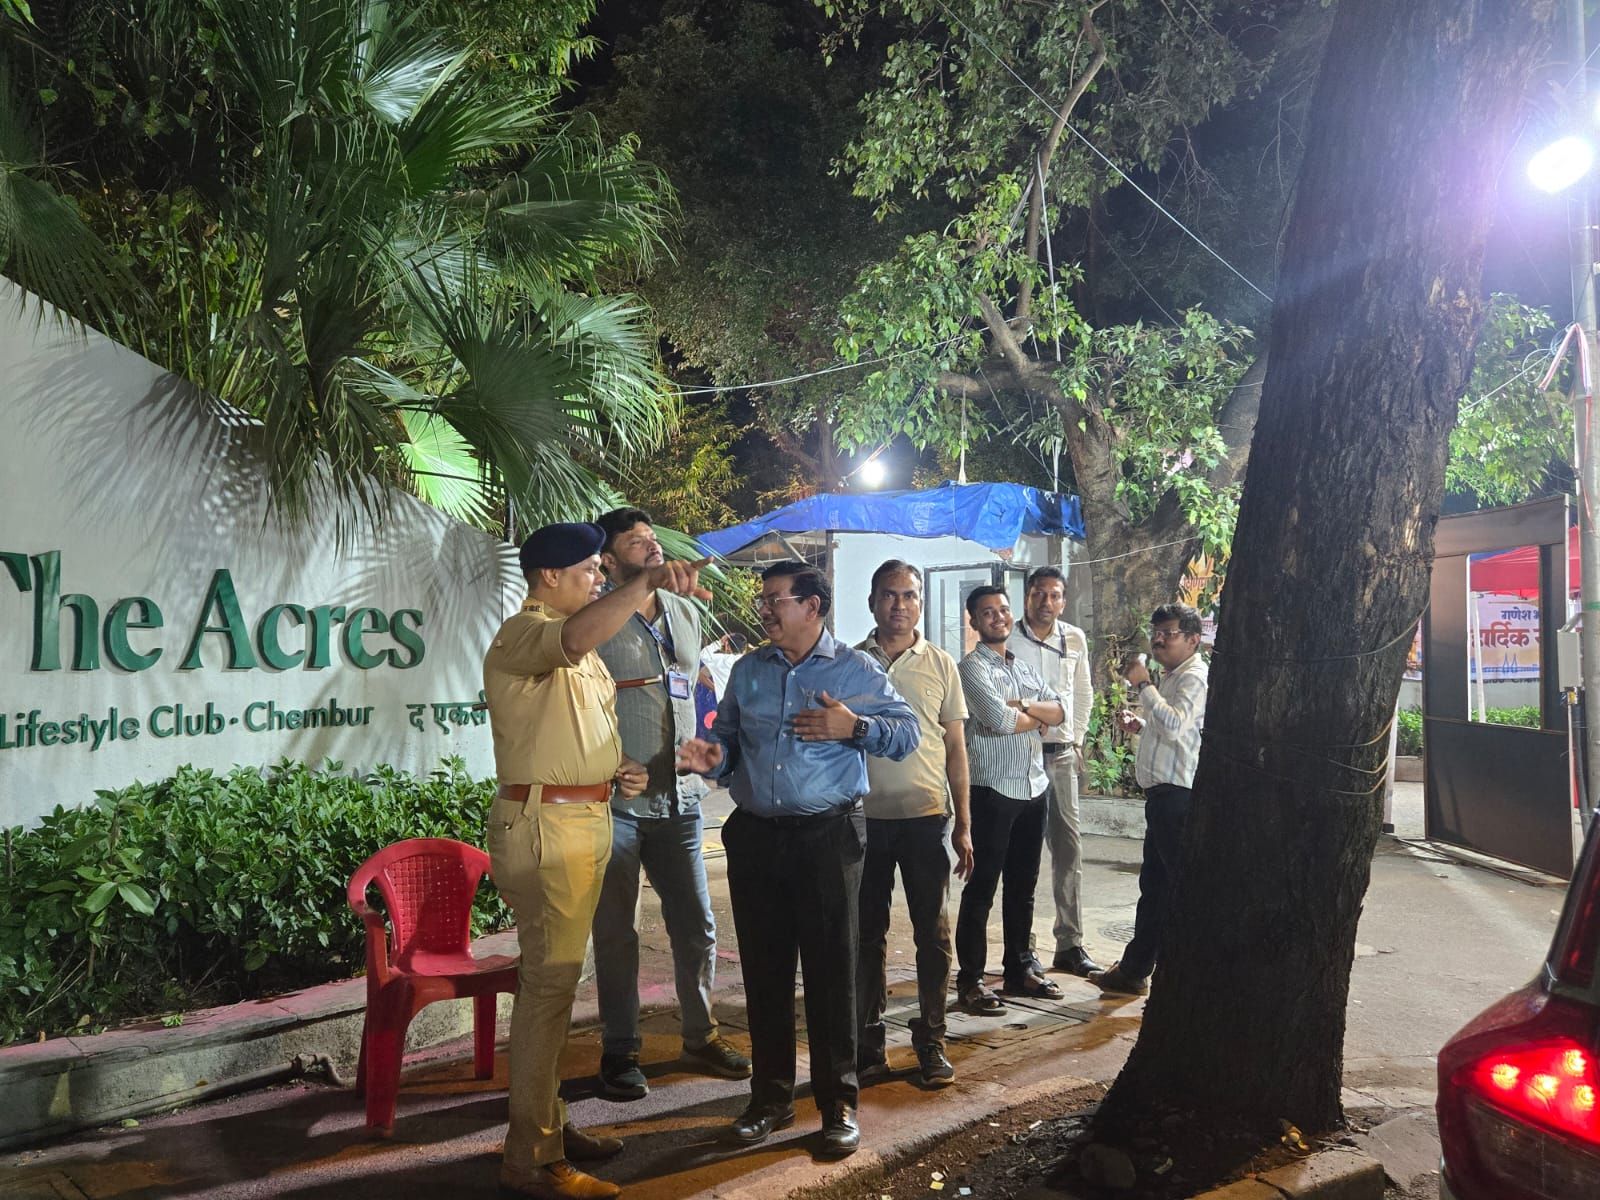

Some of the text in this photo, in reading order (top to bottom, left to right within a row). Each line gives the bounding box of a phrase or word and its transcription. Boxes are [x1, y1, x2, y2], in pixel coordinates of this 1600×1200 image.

[178, 568, 426, 670] Acres
[1501, 606, 1532, 620] गणेश
[0, 698, 375, 751] Lifestyle Club Chembur
[406, 703, 427, 732] द
